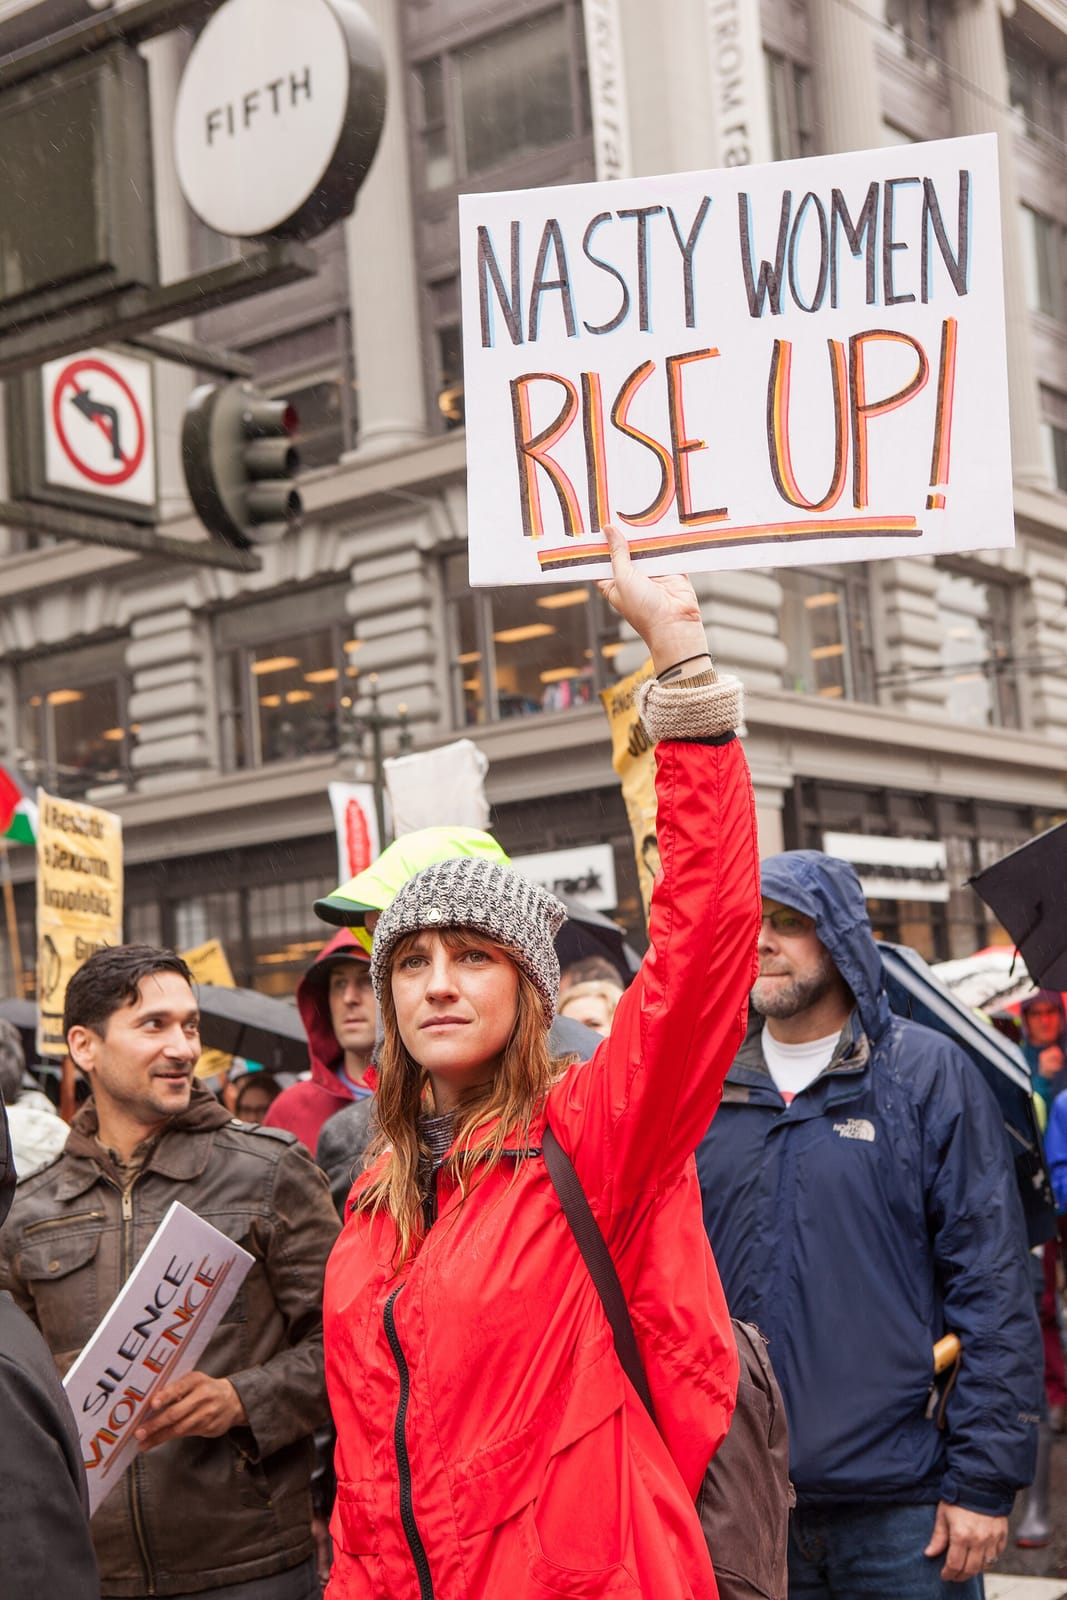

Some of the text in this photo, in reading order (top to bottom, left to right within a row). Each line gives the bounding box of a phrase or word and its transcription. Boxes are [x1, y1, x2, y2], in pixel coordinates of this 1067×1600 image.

[205, 65, 312, 146] FIFTH
[477, 169, 974, 348] NASTY WOMEN
[509, 316, 959, 540] RISE UP!
[82, 1254, 193, 1417] SILENCE
[84, 1253, 225, 1469] VIOLENCE
